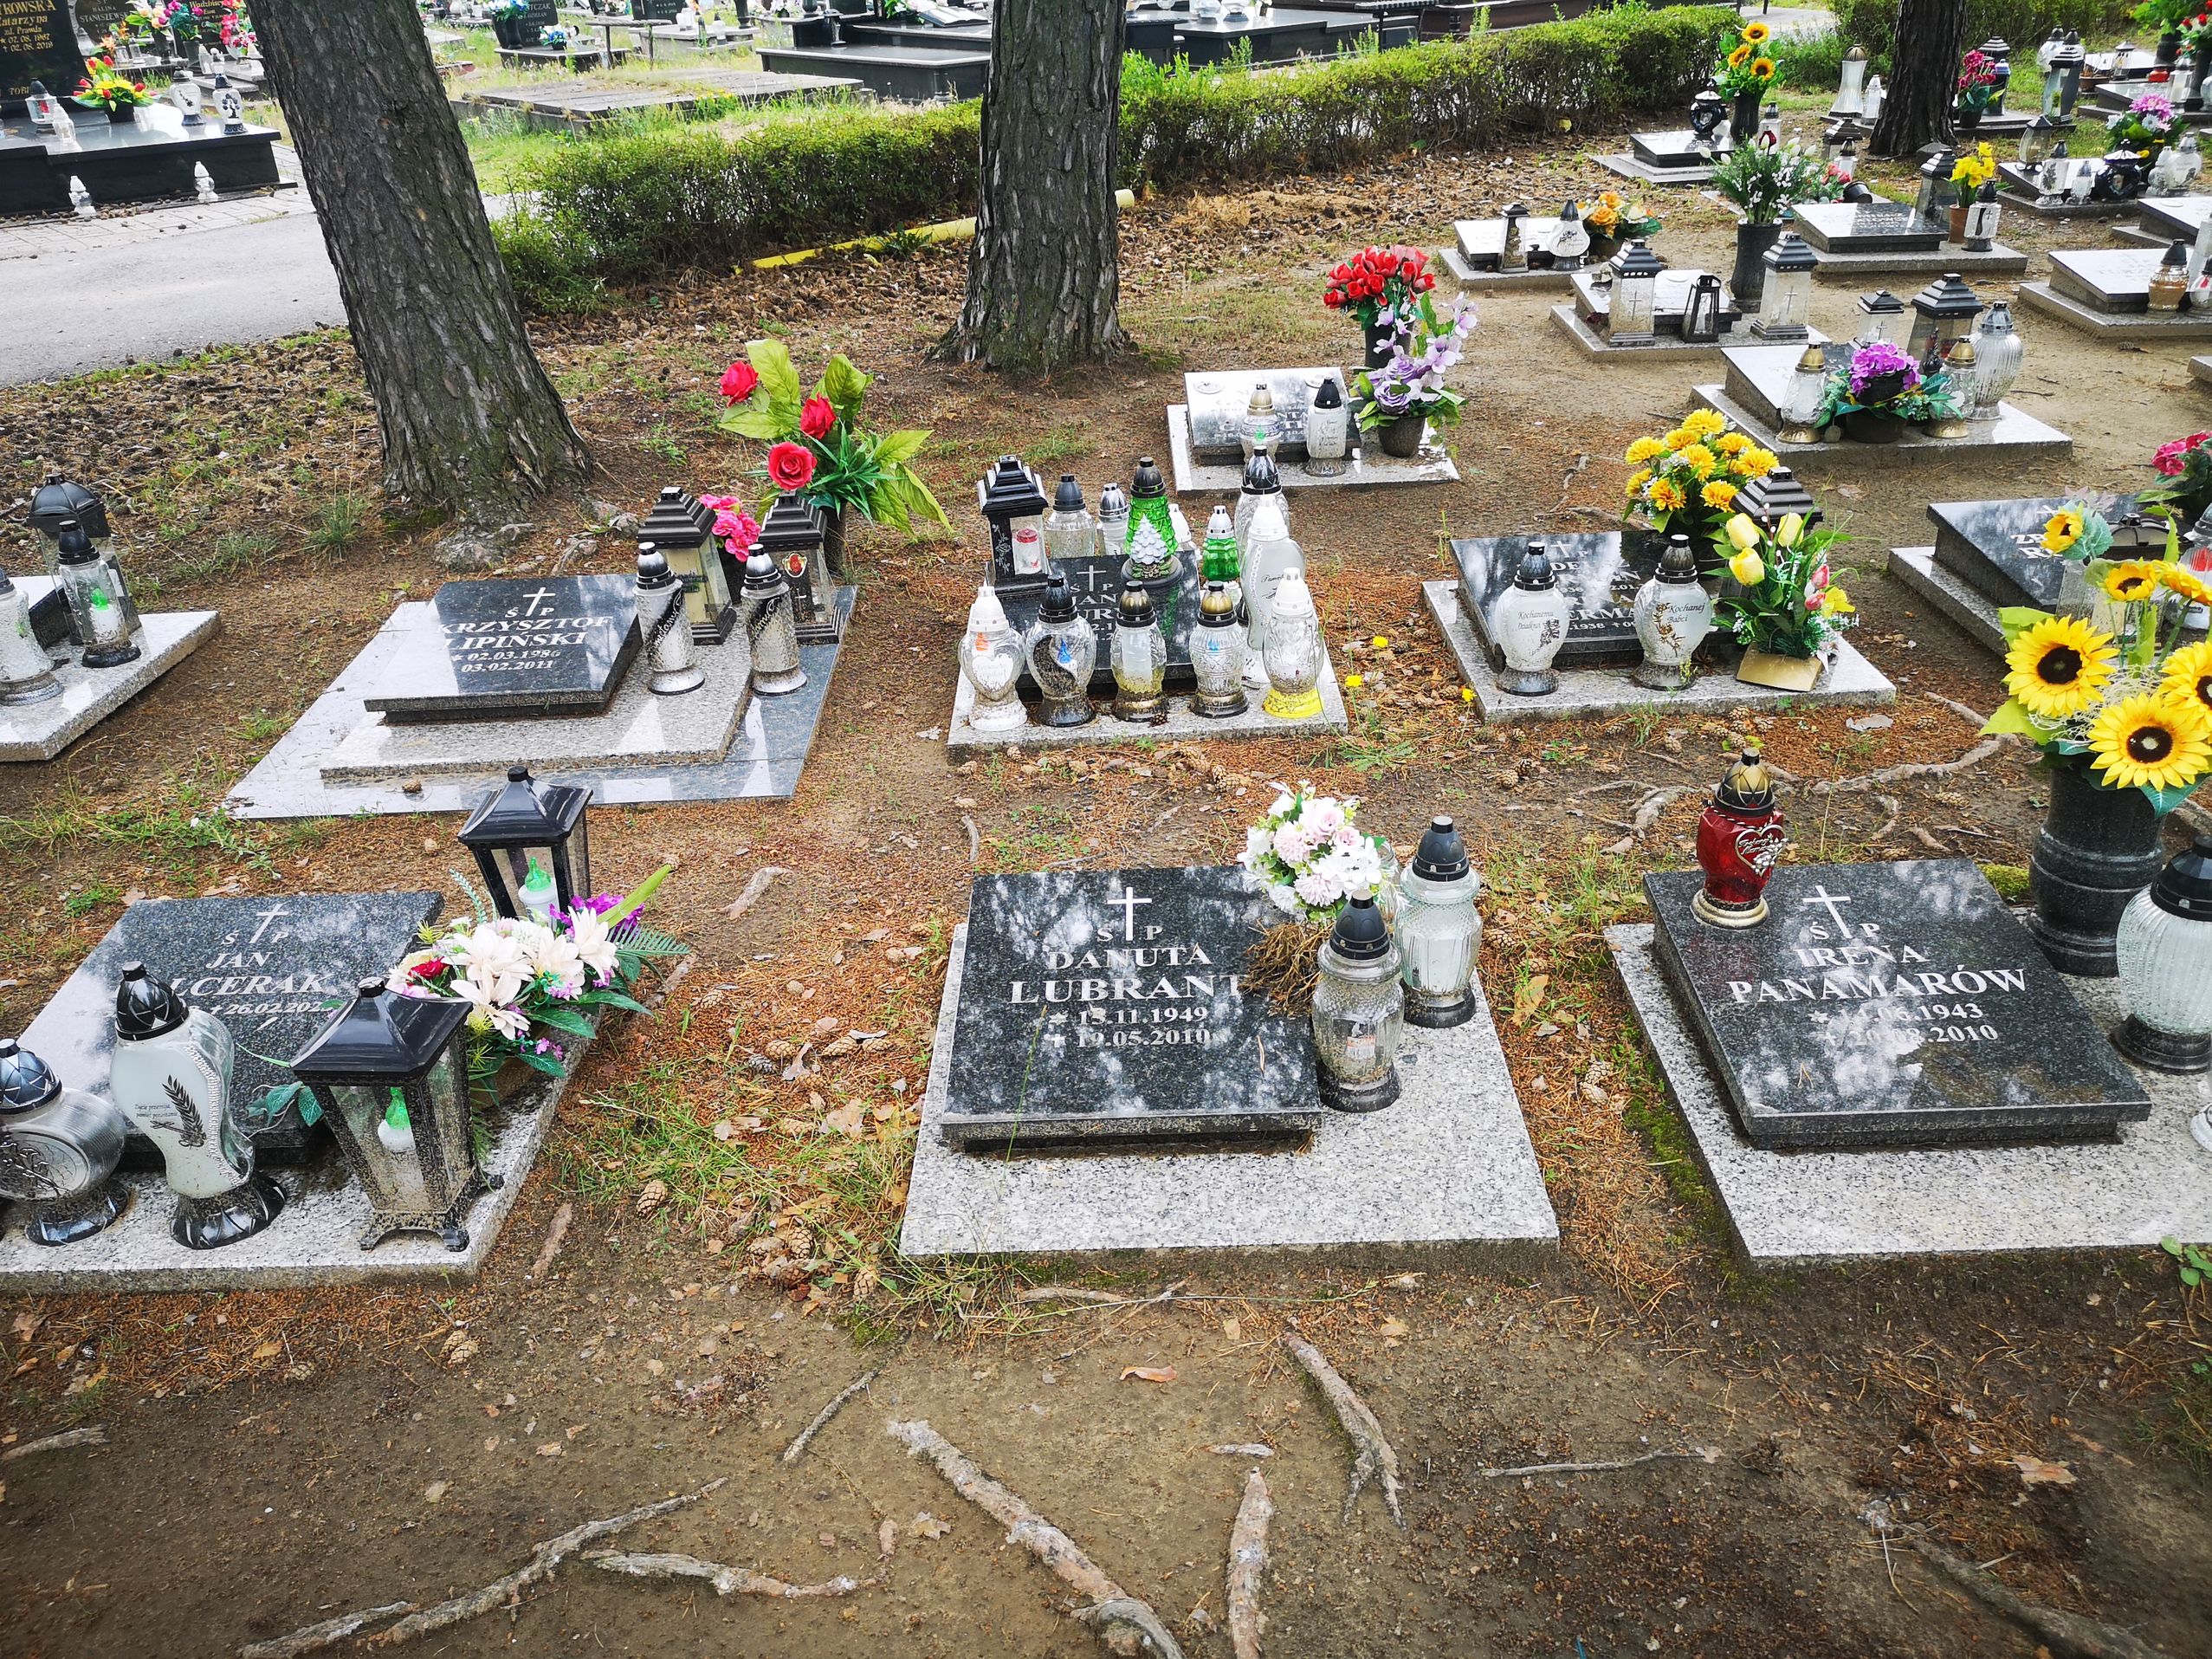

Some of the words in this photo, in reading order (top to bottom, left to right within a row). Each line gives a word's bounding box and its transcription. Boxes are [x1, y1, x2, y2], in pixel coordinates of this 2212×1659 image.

[80, 12, 128, 23] STANISZEWSK
[9, 86, 29, 95] TOBI
[505, 606, 520, 618] Ś
[539, 607, 555, 616] P
[436, 616, 613, 633] KRZYSZTOF
[445, 631, 590, 650] LIPIŃSKI
[221, 930, 240, 945] Ś
[270, 931, 289, 944] P
[1145, 925, 1164, 941] P
[1809, 921, 1830, 940] Ś
[1859, 923, 1881, 937] P
[205, 952, 275, 969] JAN
[1048, 943, 1213, 970] DANUTA
[1794, 944, 1931, 968] IRENA
[172, 974, 335, 997] LCERAK
[1009, 974, 1248, 1004] LUBRANT
[1726, 964, 2028, 1003] PANAMARÓW
